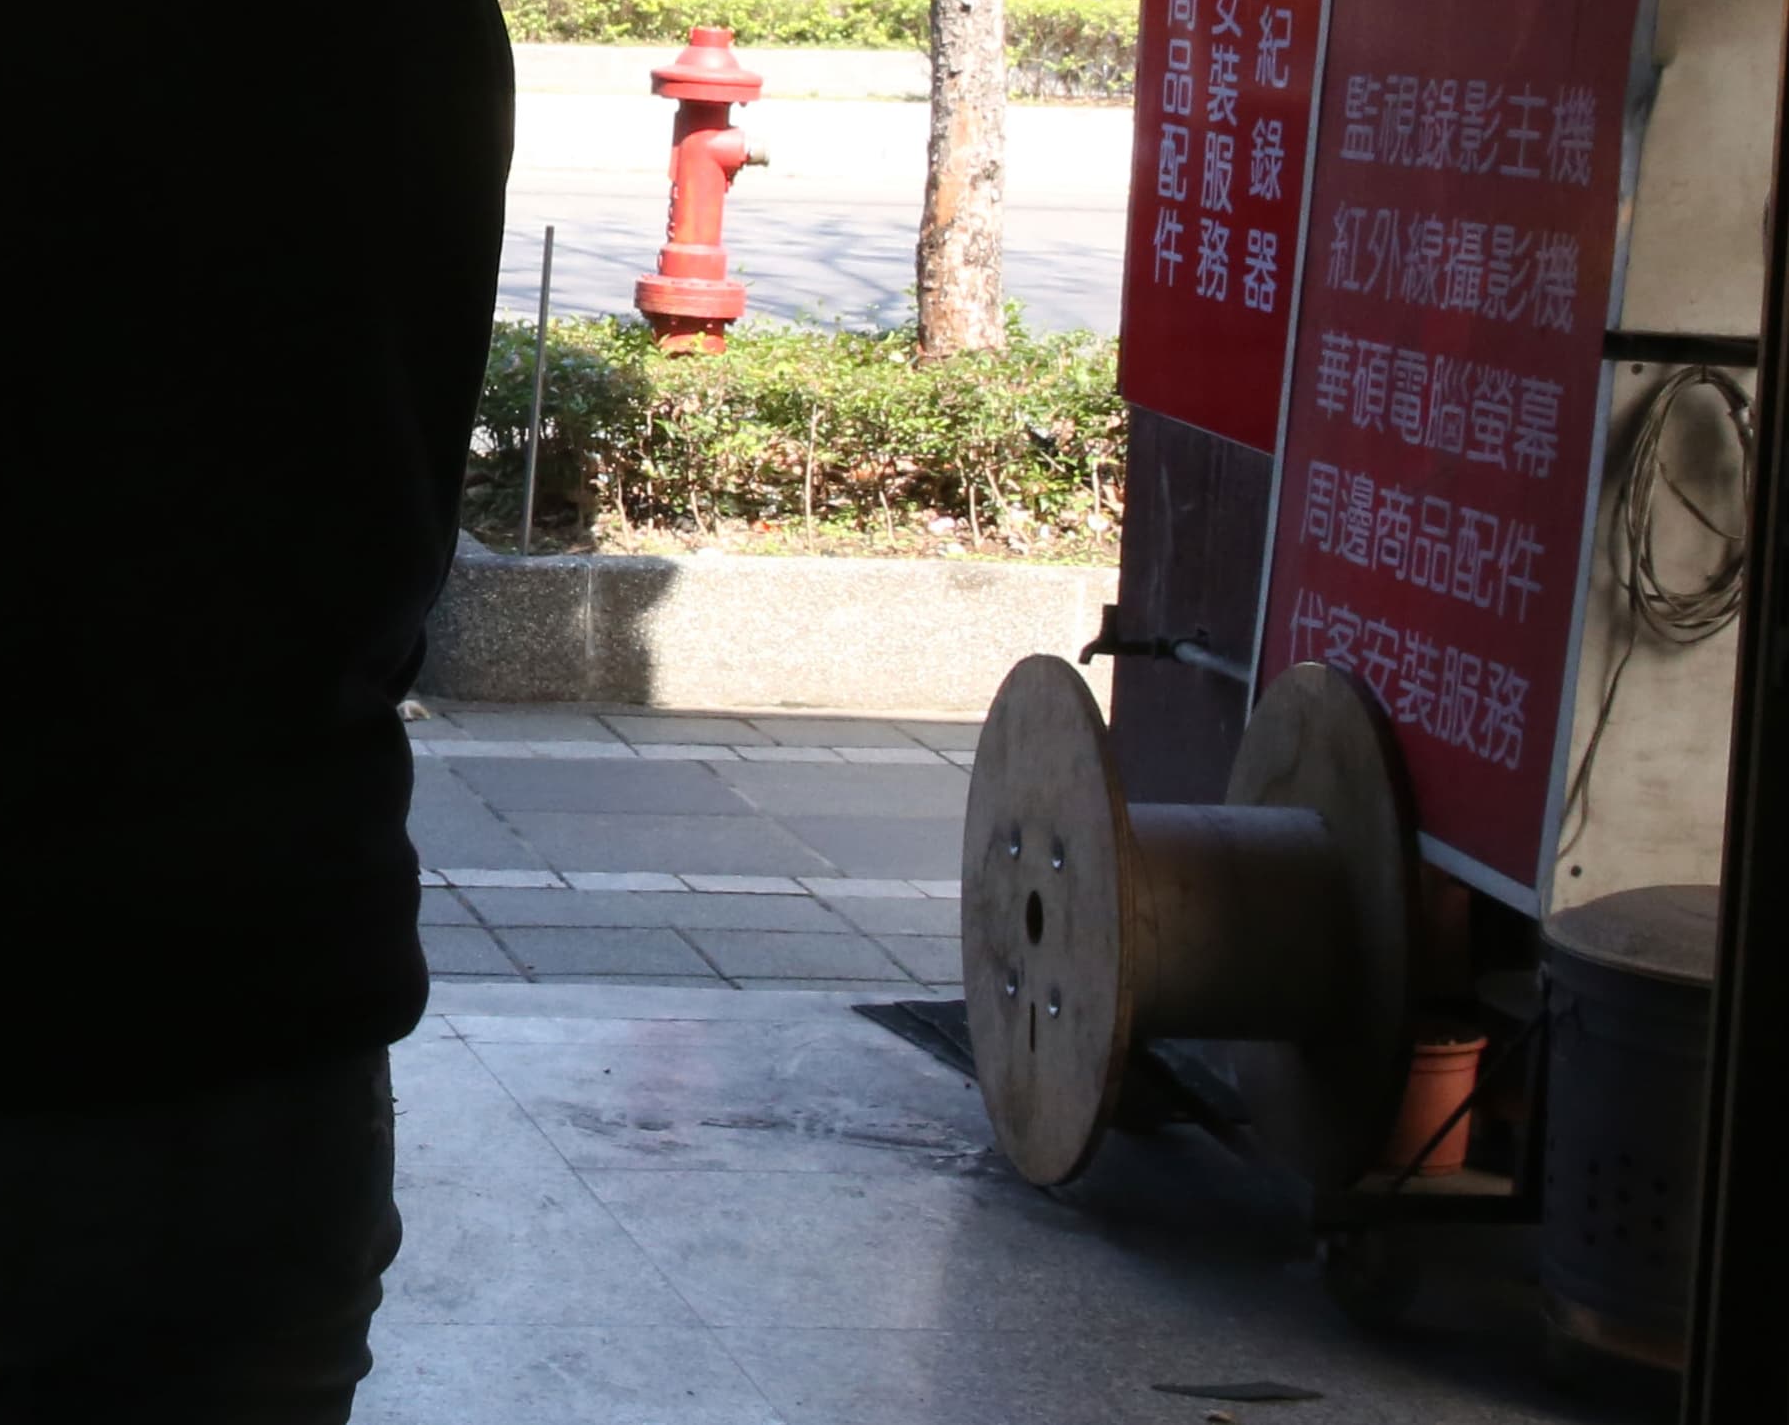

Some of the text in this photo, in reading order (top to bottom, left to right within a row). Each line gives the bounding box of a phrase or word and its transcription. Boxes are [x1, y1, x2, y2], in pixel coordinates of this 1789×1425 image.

[1340, 73, 1595, 186] 監視錄影主機
[1326, 201, 1577, 333] 紅外線攝影機
[1316, 332, 1563, 479] 華碩電腦螢幕
[1301, 460, 1544, 623] 周邊商品配件
